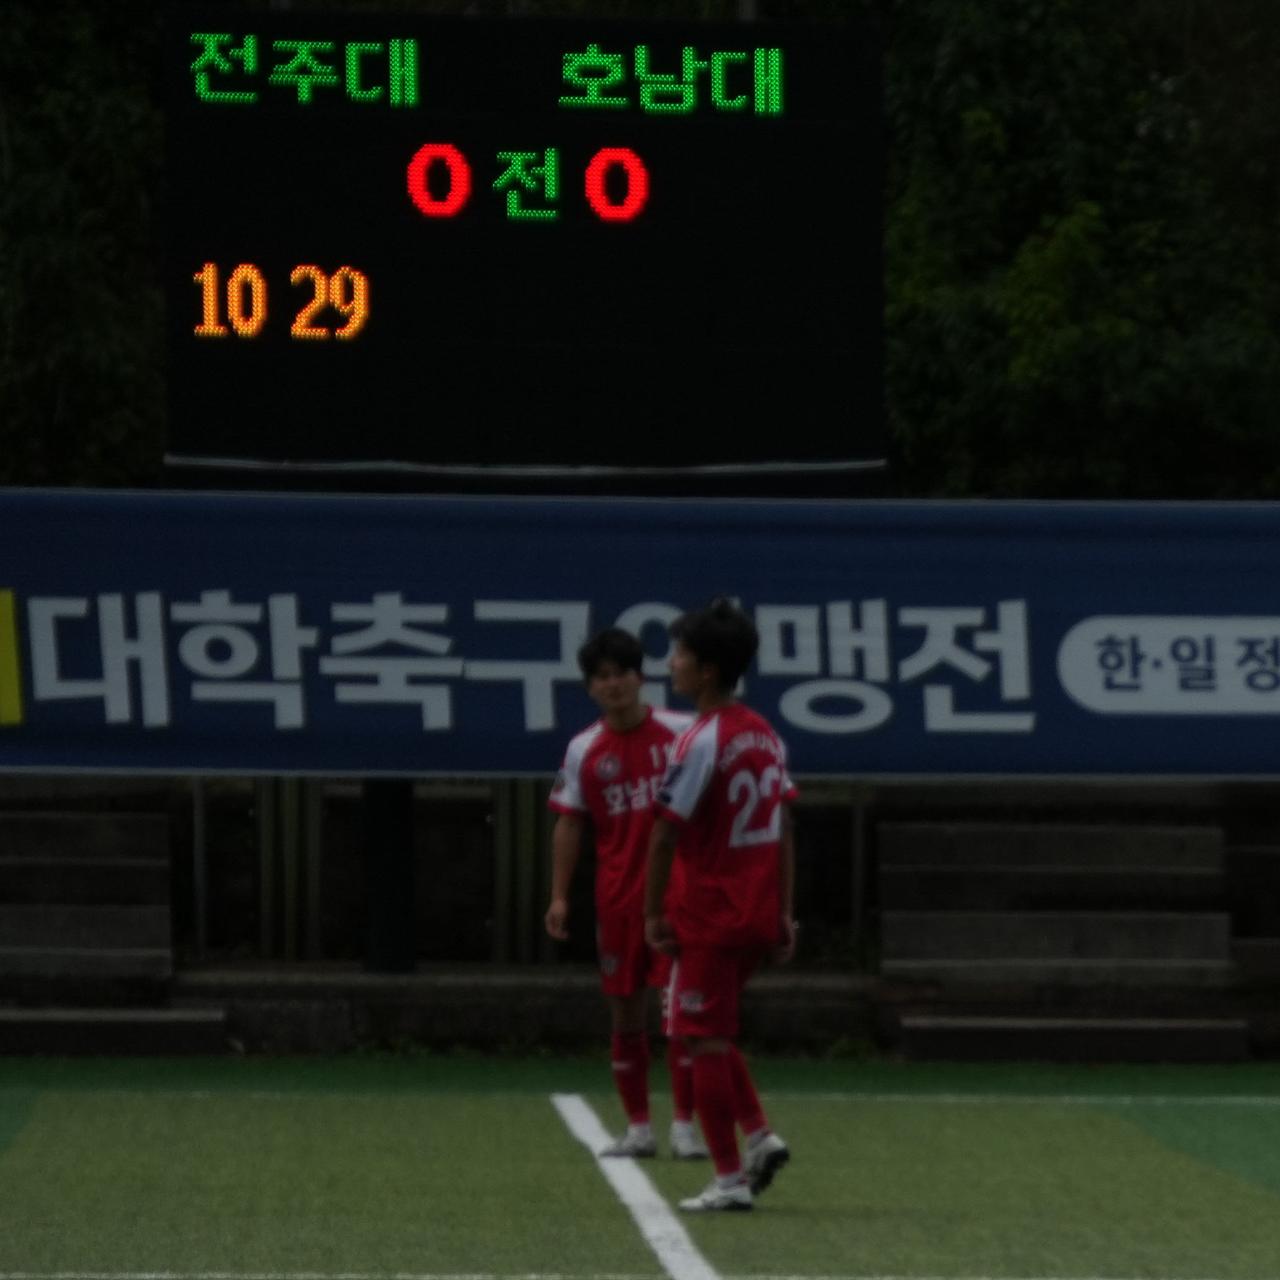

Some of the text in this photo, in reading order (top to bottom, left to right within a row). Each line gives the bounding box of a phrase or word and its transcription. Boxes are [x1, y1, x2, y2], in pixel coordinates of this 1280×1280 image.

[190, 32, 788, 119] 전주대 호남대
[404, 141, 652, 224] 0 전 0
[192, 261, 371, 343] 10 29
[1096, 634, 1217, 693] 한·일
